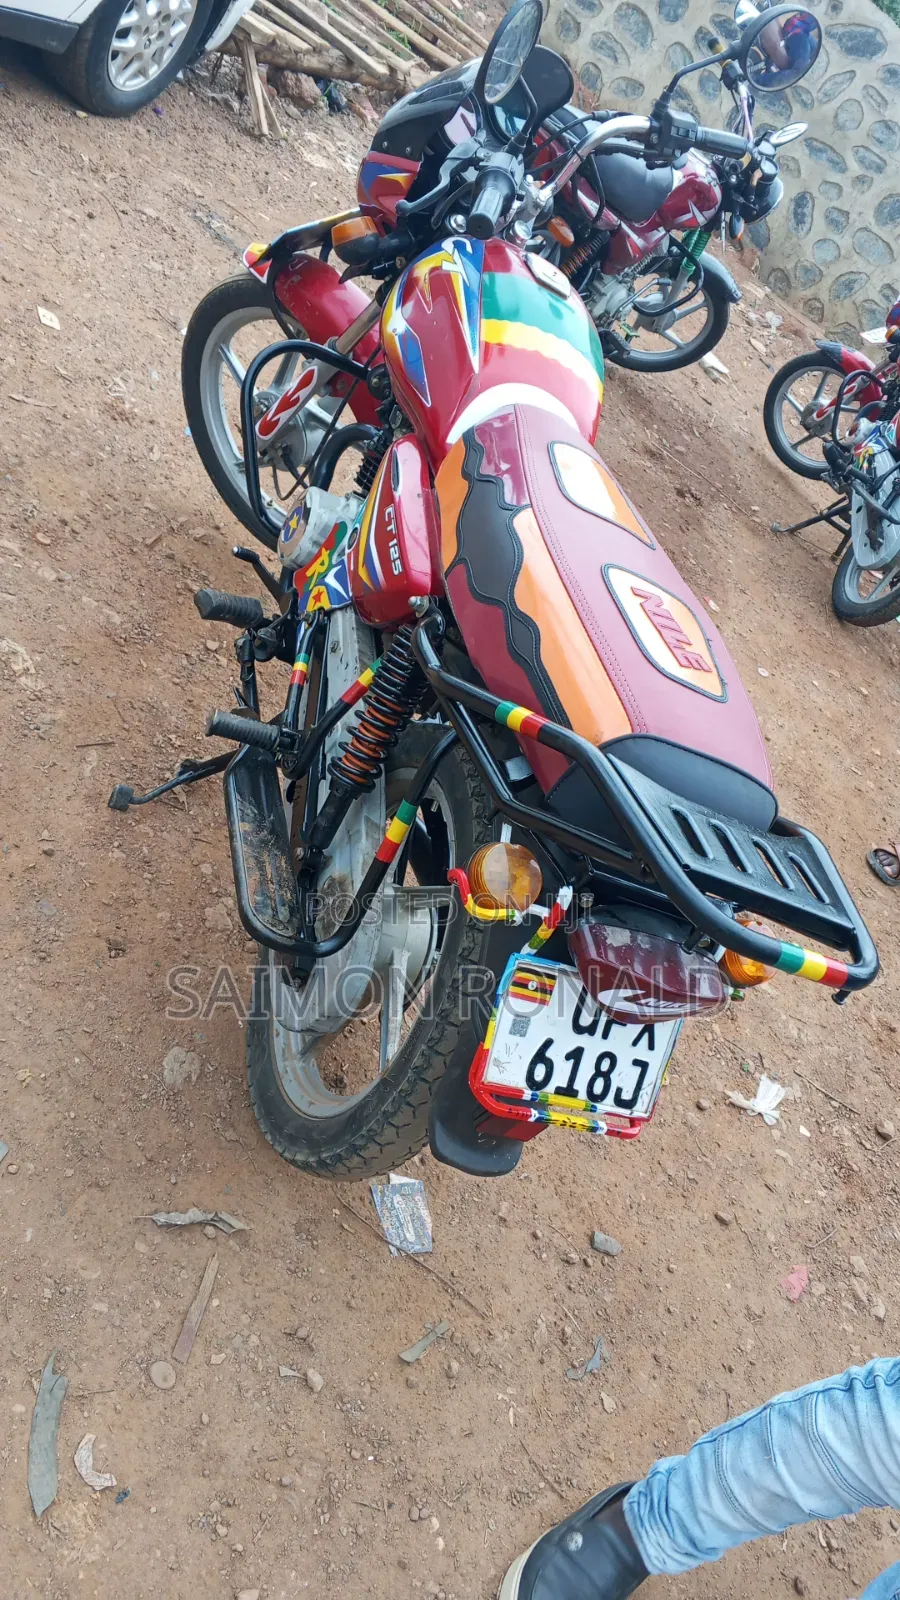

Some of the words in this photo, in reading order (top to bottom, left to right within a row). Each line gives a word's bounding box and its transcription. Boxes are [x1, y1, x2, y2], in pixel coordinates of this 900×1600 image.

[384, 504, 400, 536] CT
[388, 538, 403, 576] 125
[525, 1038, 650, 1110] 618J
